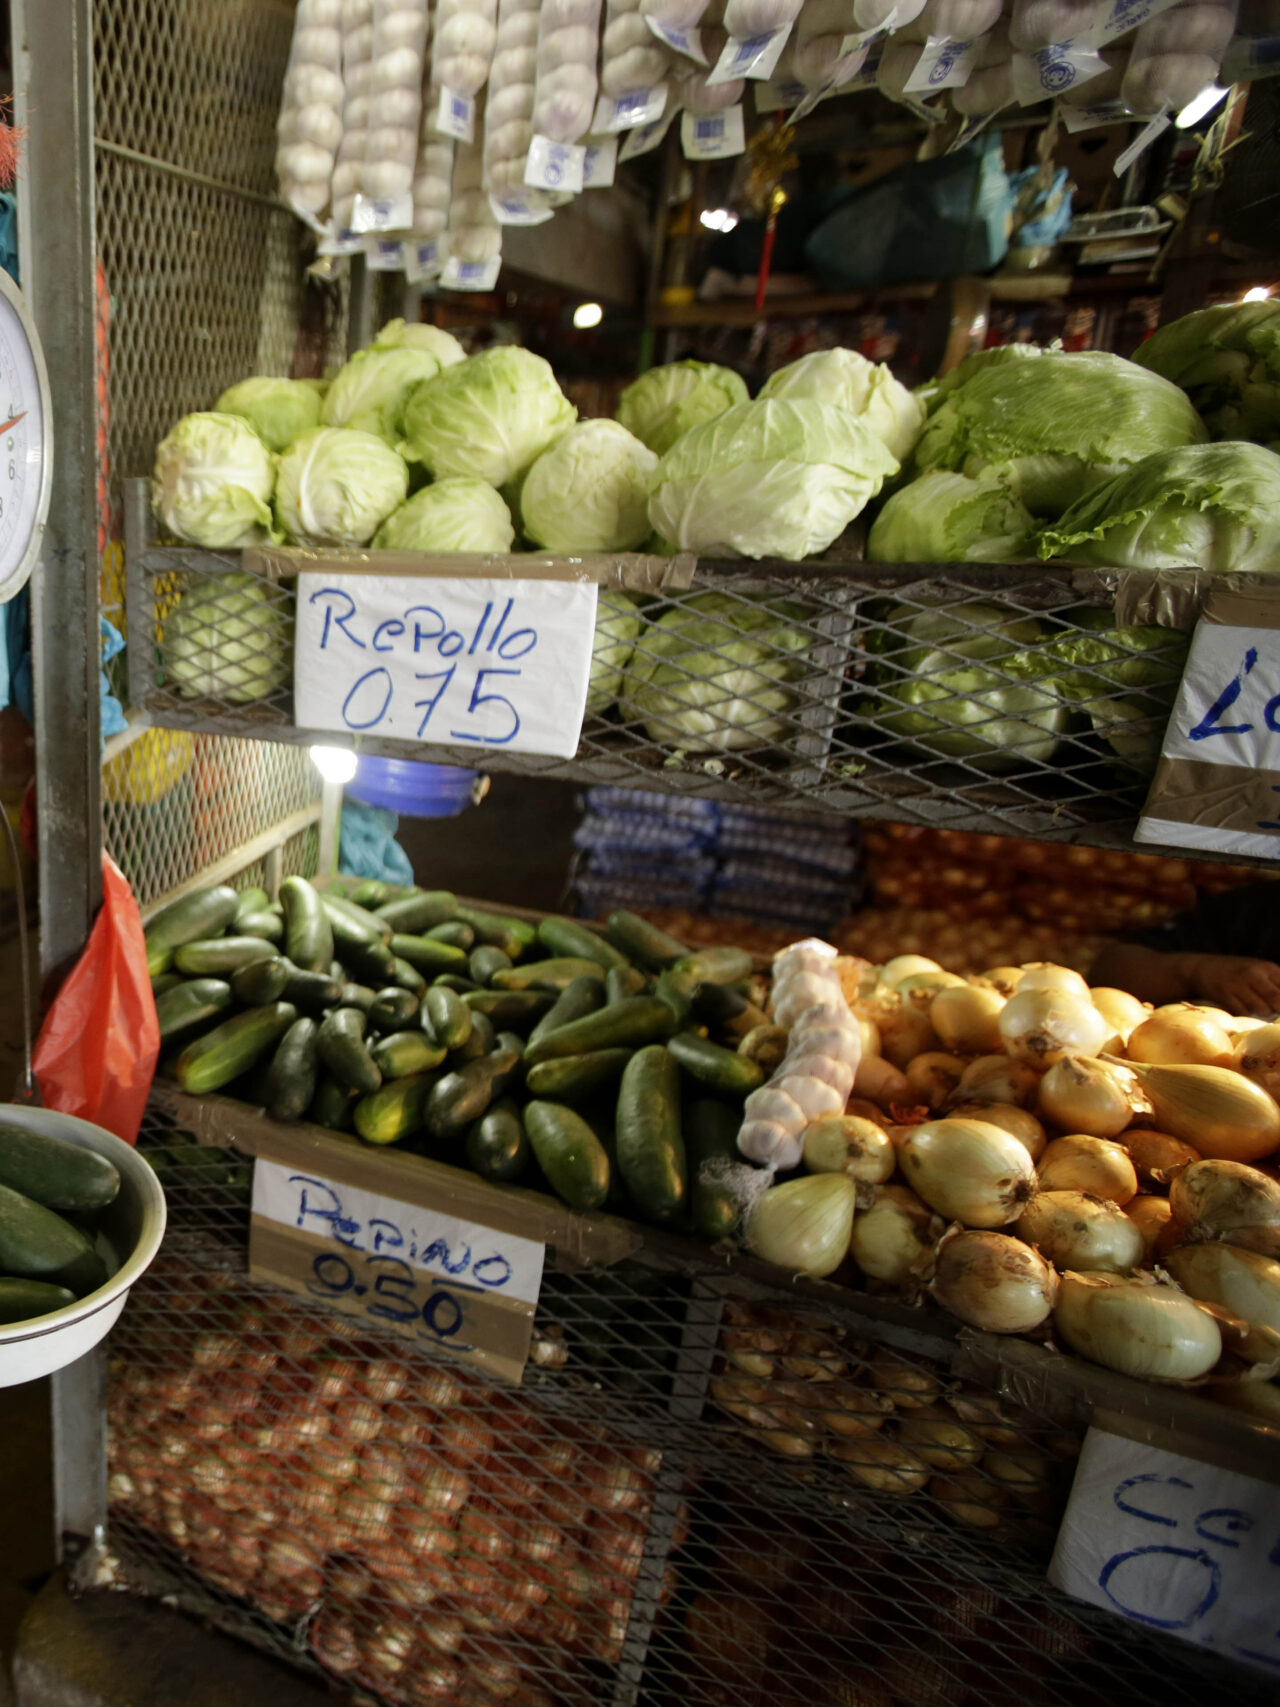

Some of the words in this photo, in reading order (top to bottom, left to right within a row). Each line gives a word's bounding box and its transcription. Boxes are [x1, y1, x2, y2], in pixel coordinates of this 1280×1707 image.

[8, 459, 16, 480] 6
[342, 663, 521, 744] 0.75
[312, 1252, 466, 1337] 0.50
[1113, 1473, 1280, 1567] Ce
